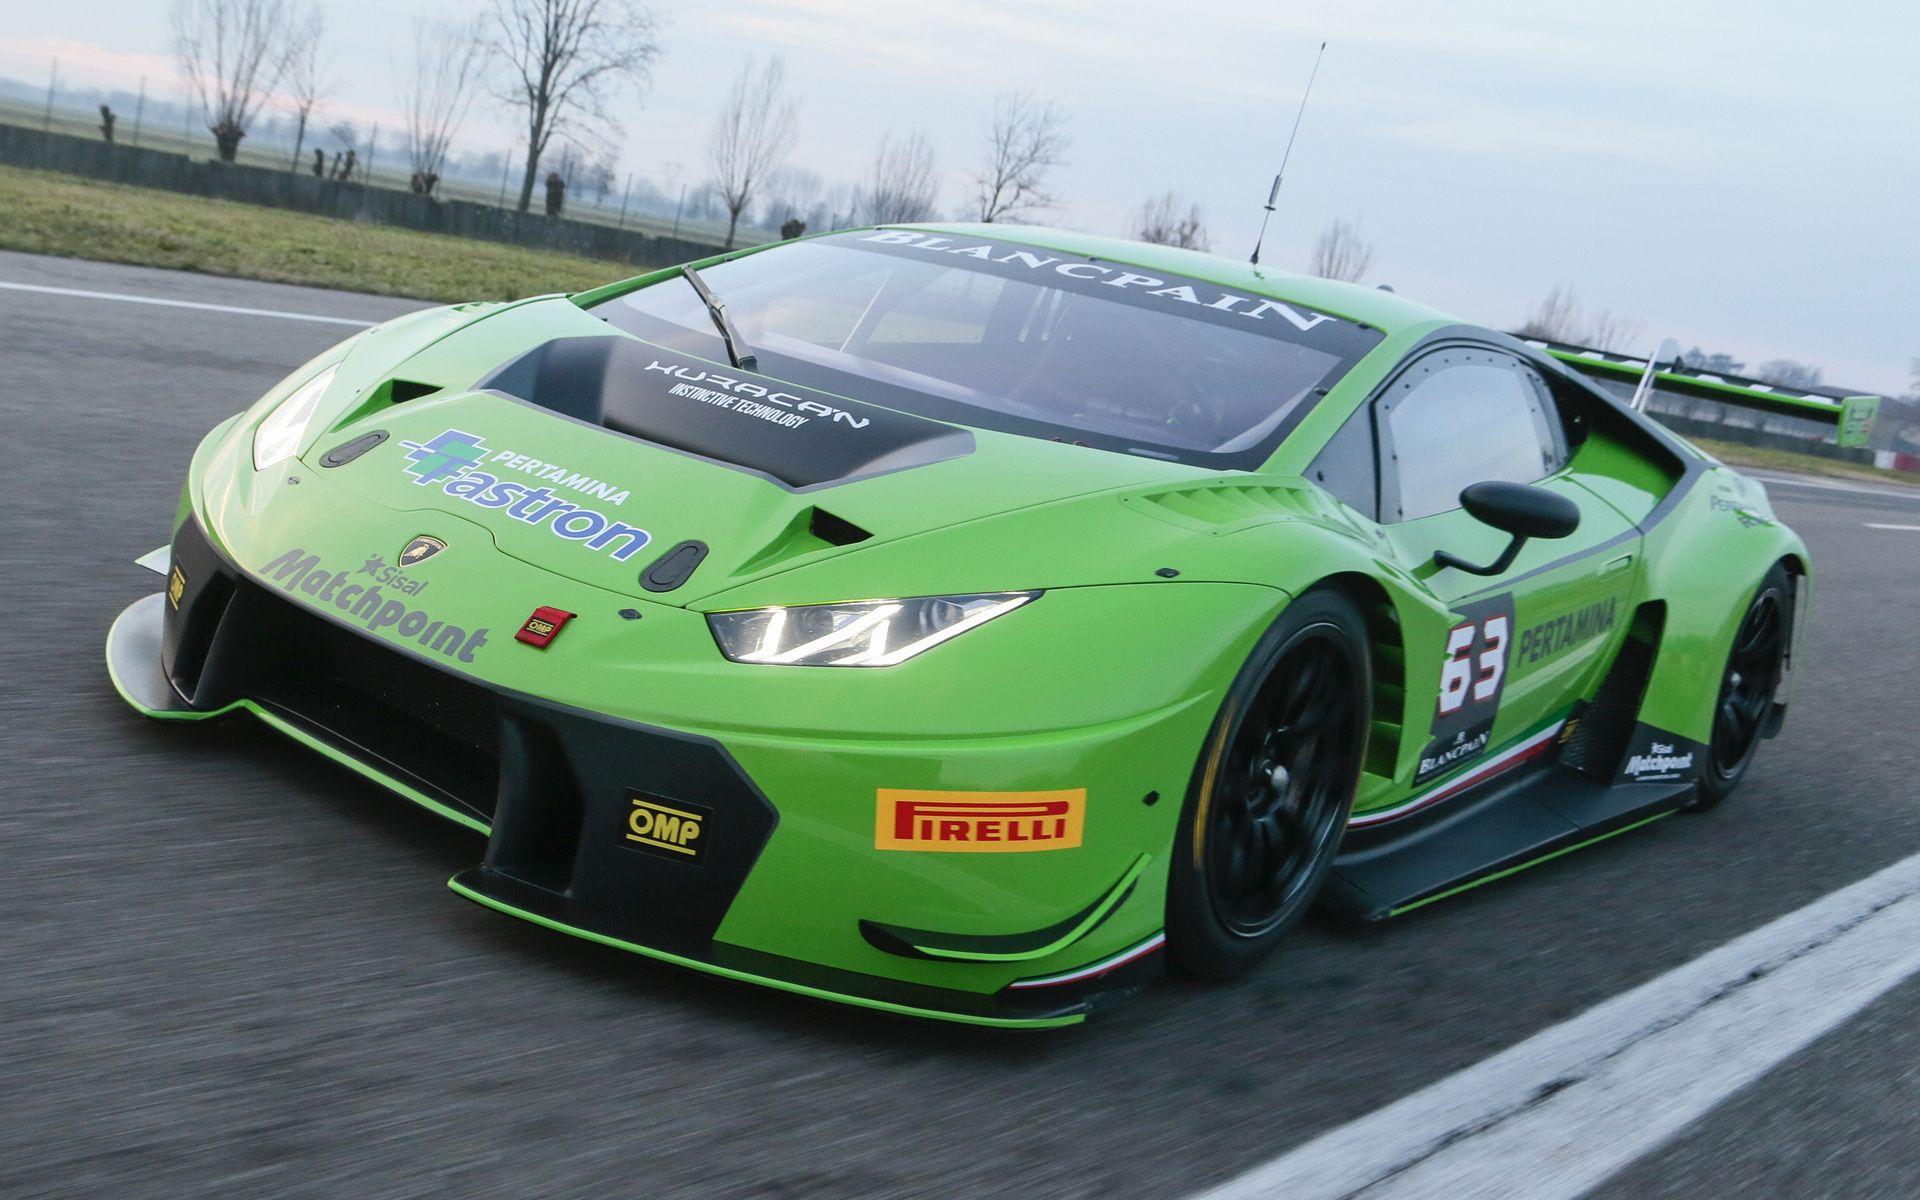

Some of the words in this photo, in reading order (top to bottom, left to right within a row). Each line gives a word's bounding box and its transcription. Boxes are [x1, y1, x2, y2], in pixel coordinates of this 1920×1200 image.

[859, 231, 1337, 333] BLANCPAIN
[668, 381, 742, 410] INSTINCTIVE
[733, 399, 810, 430] TECHNOLOGY
[399, 428, 653, 563] Fastron
[490, 450, 631, 506] PERTAMINA
[258, 548, 490, 664] Matchpoint
[375, 565, 429, 597] Sisal
[528, 621, 553, 634] OMP
[1516, 596, 1617, 668] PERTAMINA
[1438, 615, 1509, 716] 63
[628, 808, 701, 846] OMP
[893, 800, 1070, 842] PIRELLI
